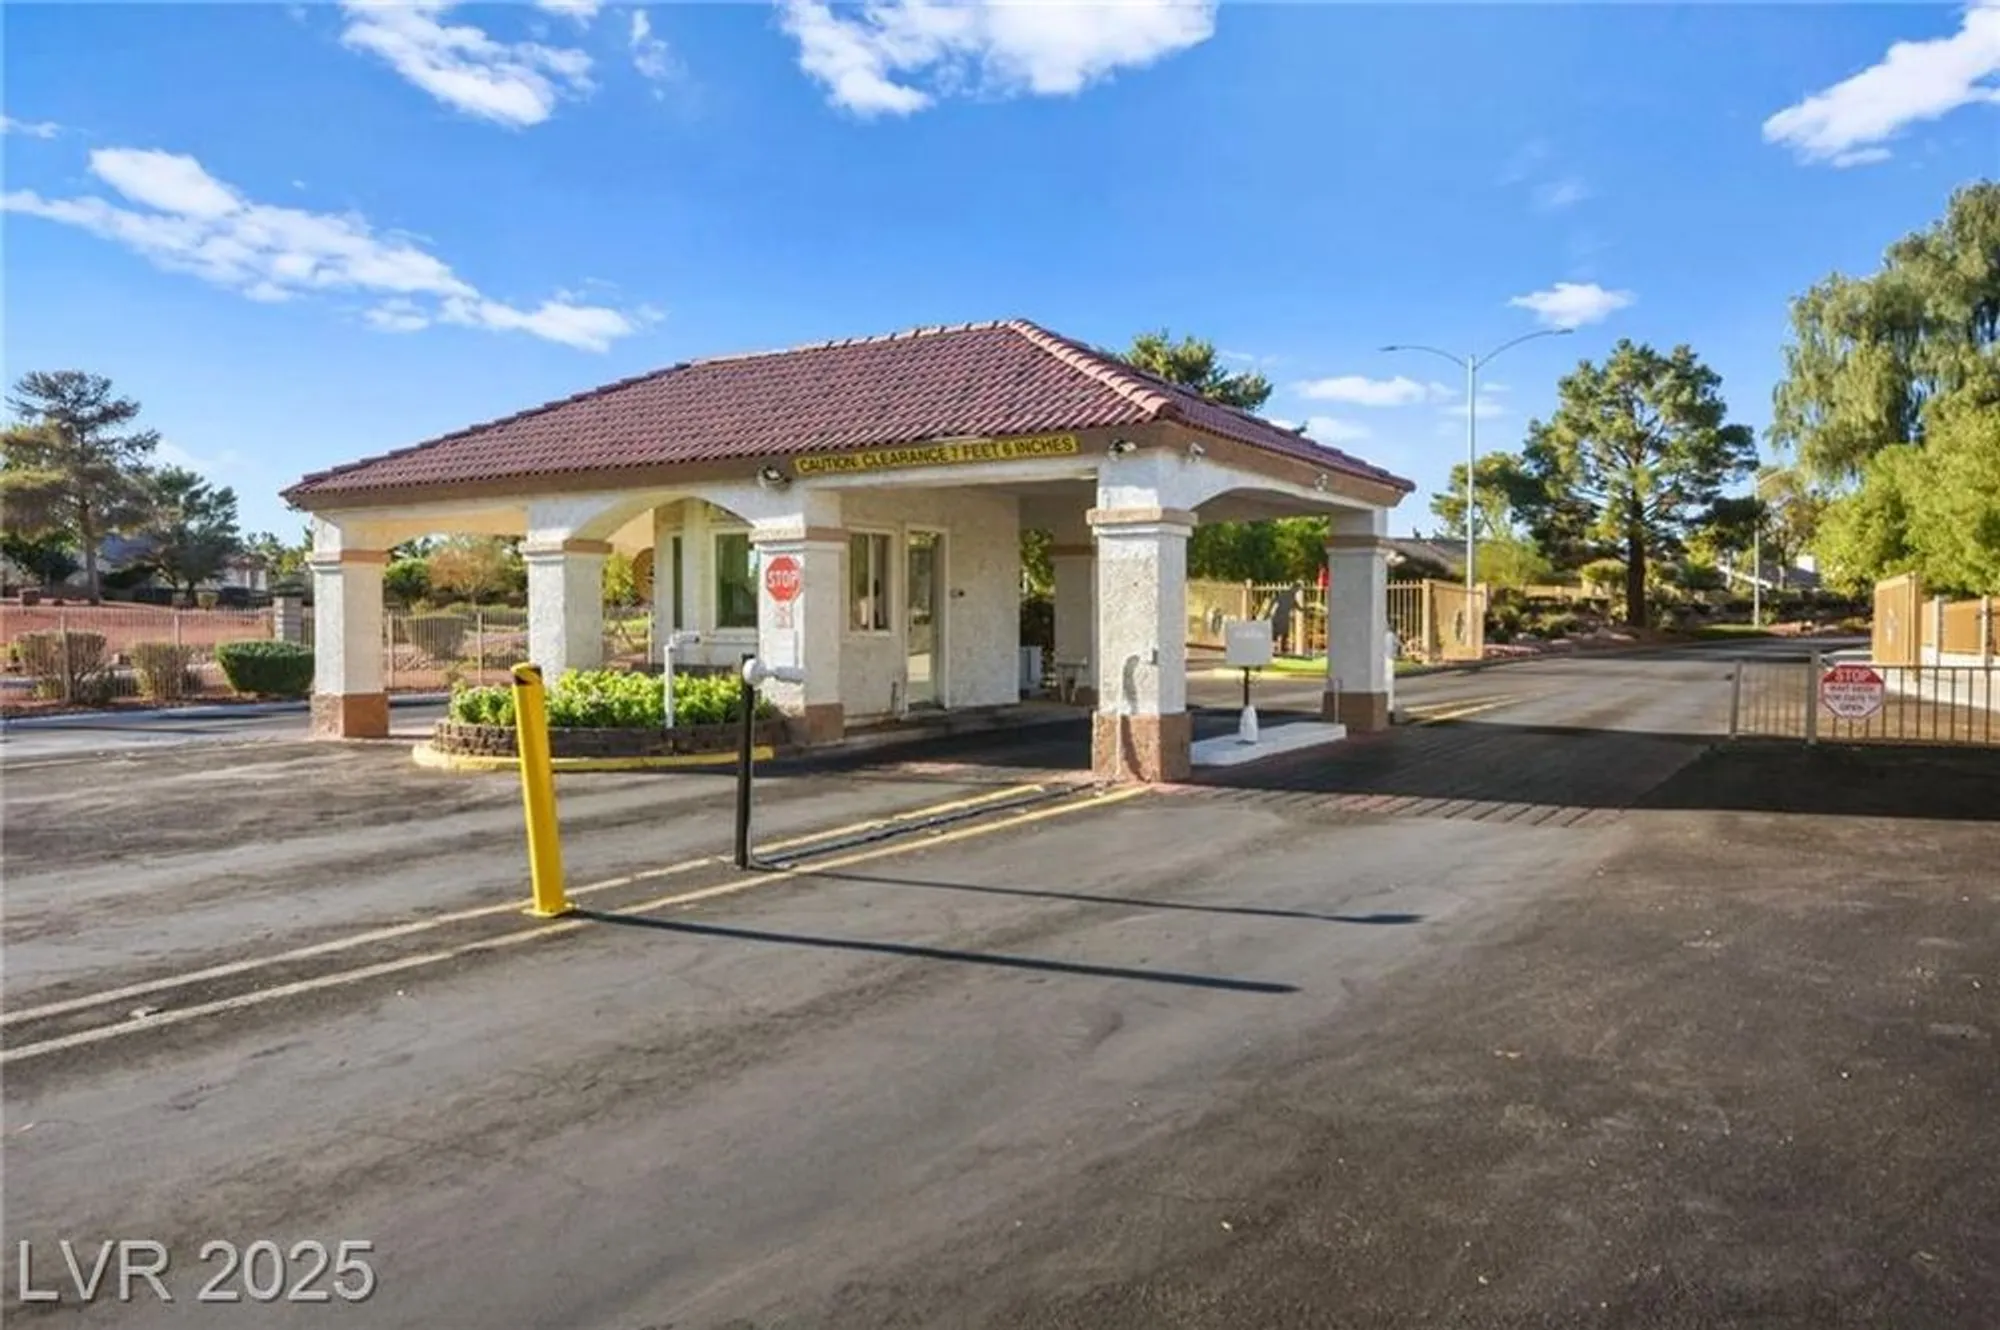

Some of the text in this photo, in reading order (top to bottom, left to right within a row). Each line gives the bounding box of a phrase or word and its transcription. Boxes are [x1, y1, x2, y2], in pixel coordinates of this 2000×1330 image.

[862, 448, 949, 466] CLEARANCE
[961, 442, 999, 460] FEET
[1015, 437, 1073, 454] INCHES
[767, 569, 800, 588] STOP
[1835, 669, 1871, 682] STOP
